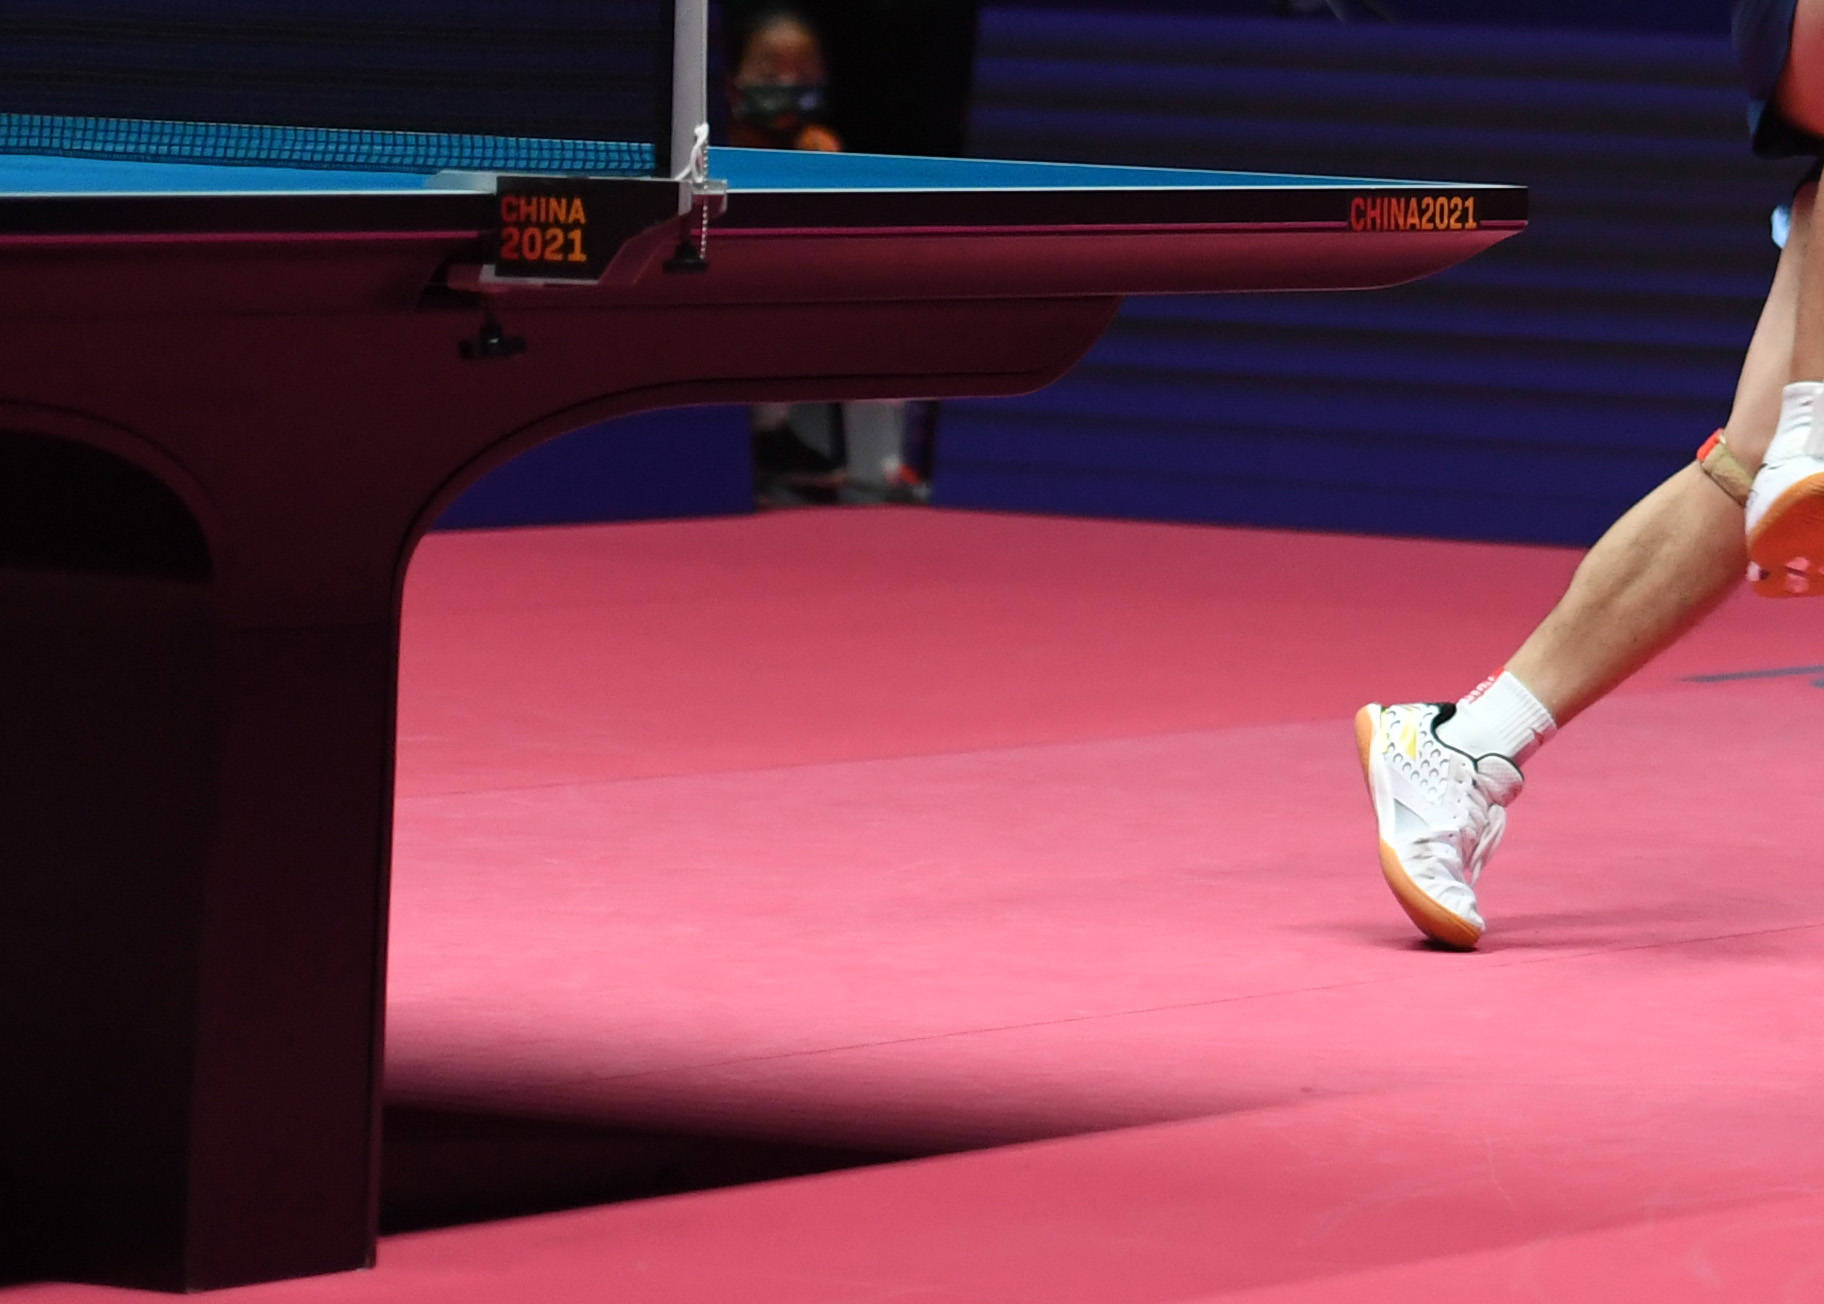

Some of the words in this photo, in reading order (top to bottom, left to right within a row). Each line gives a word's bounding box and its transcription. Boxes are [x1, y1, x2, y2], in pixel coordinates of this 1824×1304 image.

[500, 195, 588, 224] CHINA
[1350, 195, 1479, 232] CHINA2021
[500, 226, 588, 262] 2021
